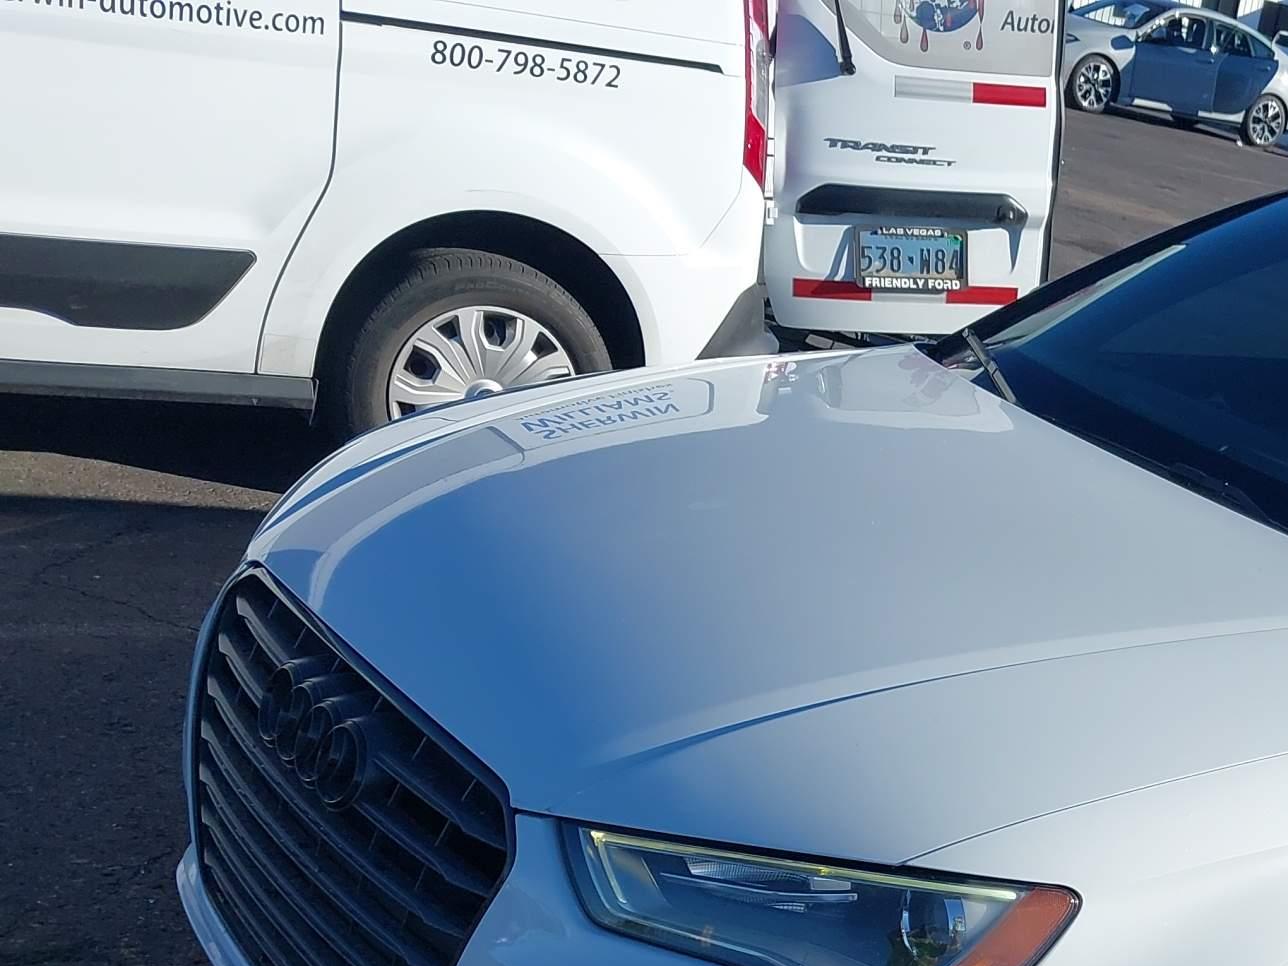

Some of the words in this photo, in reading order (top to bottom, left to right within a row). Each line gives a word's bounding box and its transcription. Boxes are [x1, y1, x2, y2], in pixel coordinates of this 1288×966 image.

[430, 40, 621, 88] 800-798-5872
[823, 138, 936, 155] TRANSIT
[875, 155, 957, 166] CONNECT
[882, 227, 904, 235] LAS
[905, 228, 942, 237] VEGAS
[865, 277, 926, 289] FRIENDLY
[928, 279, 961, 290] FORD
